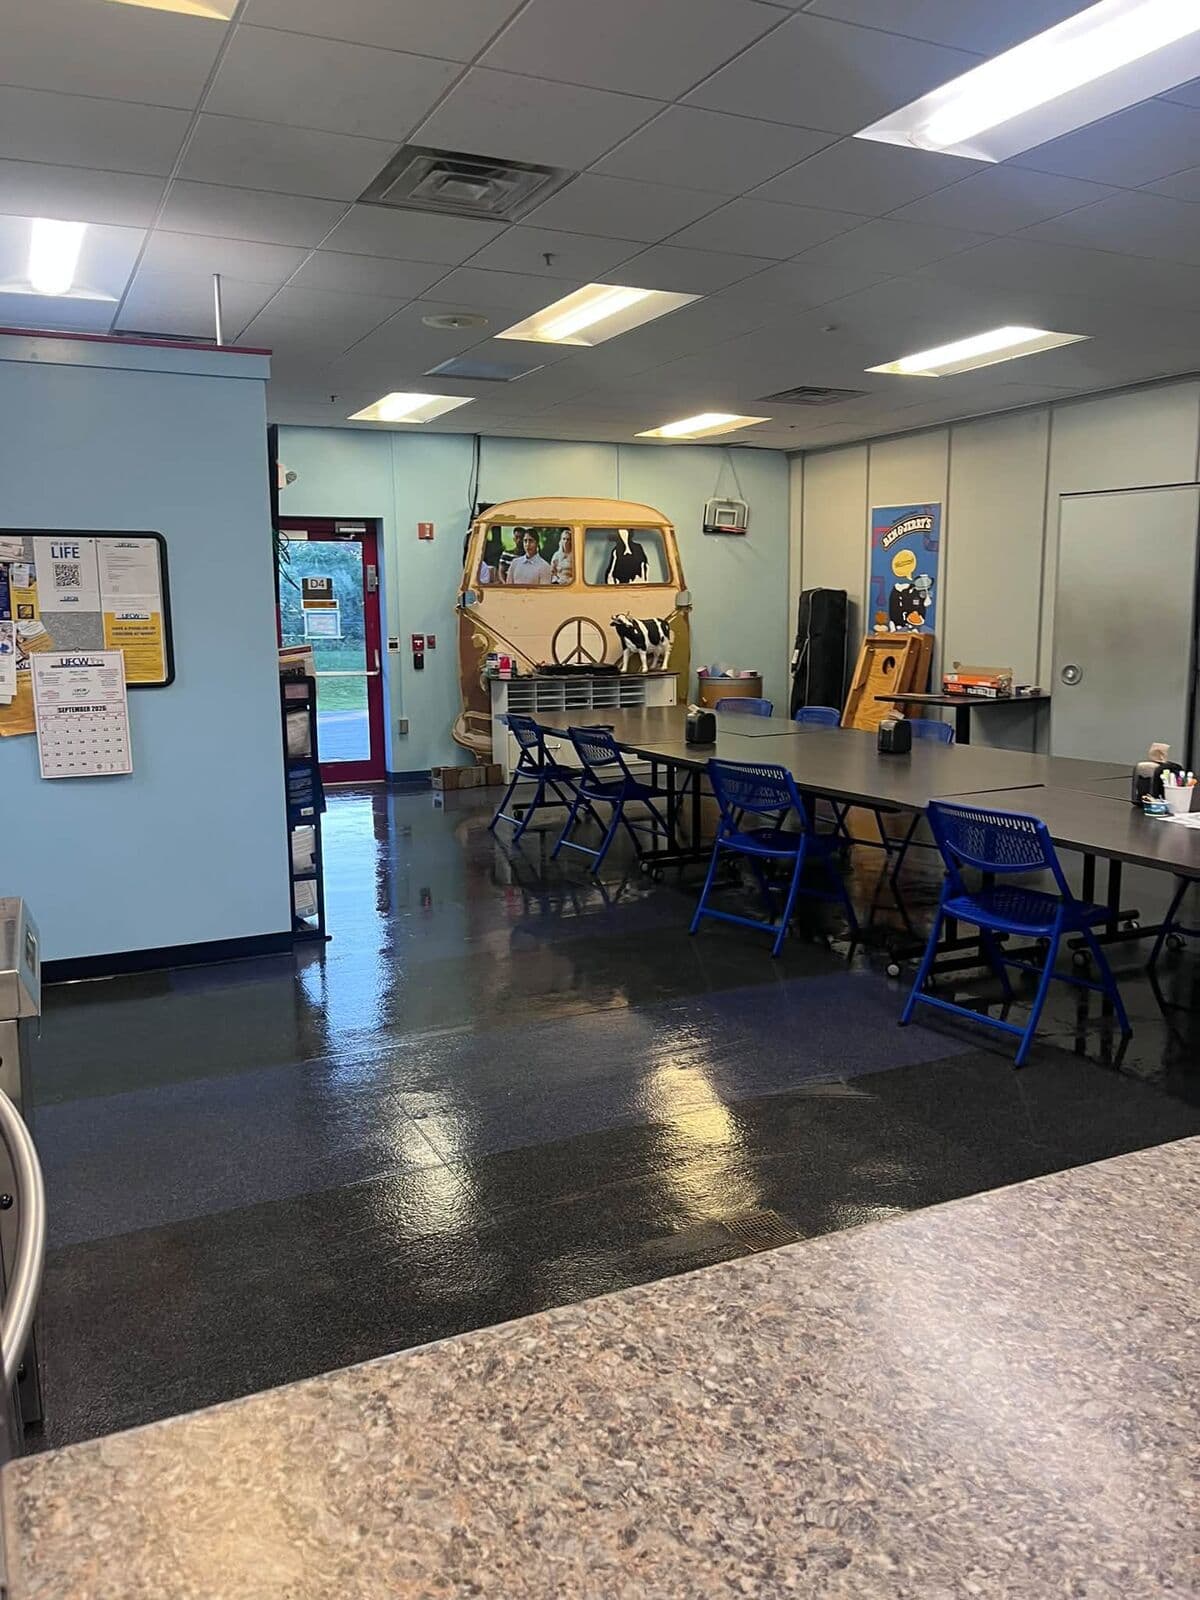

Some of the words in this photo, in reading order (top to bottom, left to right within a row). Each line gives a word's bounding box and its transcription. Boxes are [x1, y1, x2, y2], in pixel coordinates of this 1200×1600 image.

[882, 528, 898, 547] BEN
[903, 517, 931, 532] JERRY'S
[51, 546, 80, 559] LIFE
[310, 579, 324, 588] D4
[61, 658, 88, 666] UFCW
